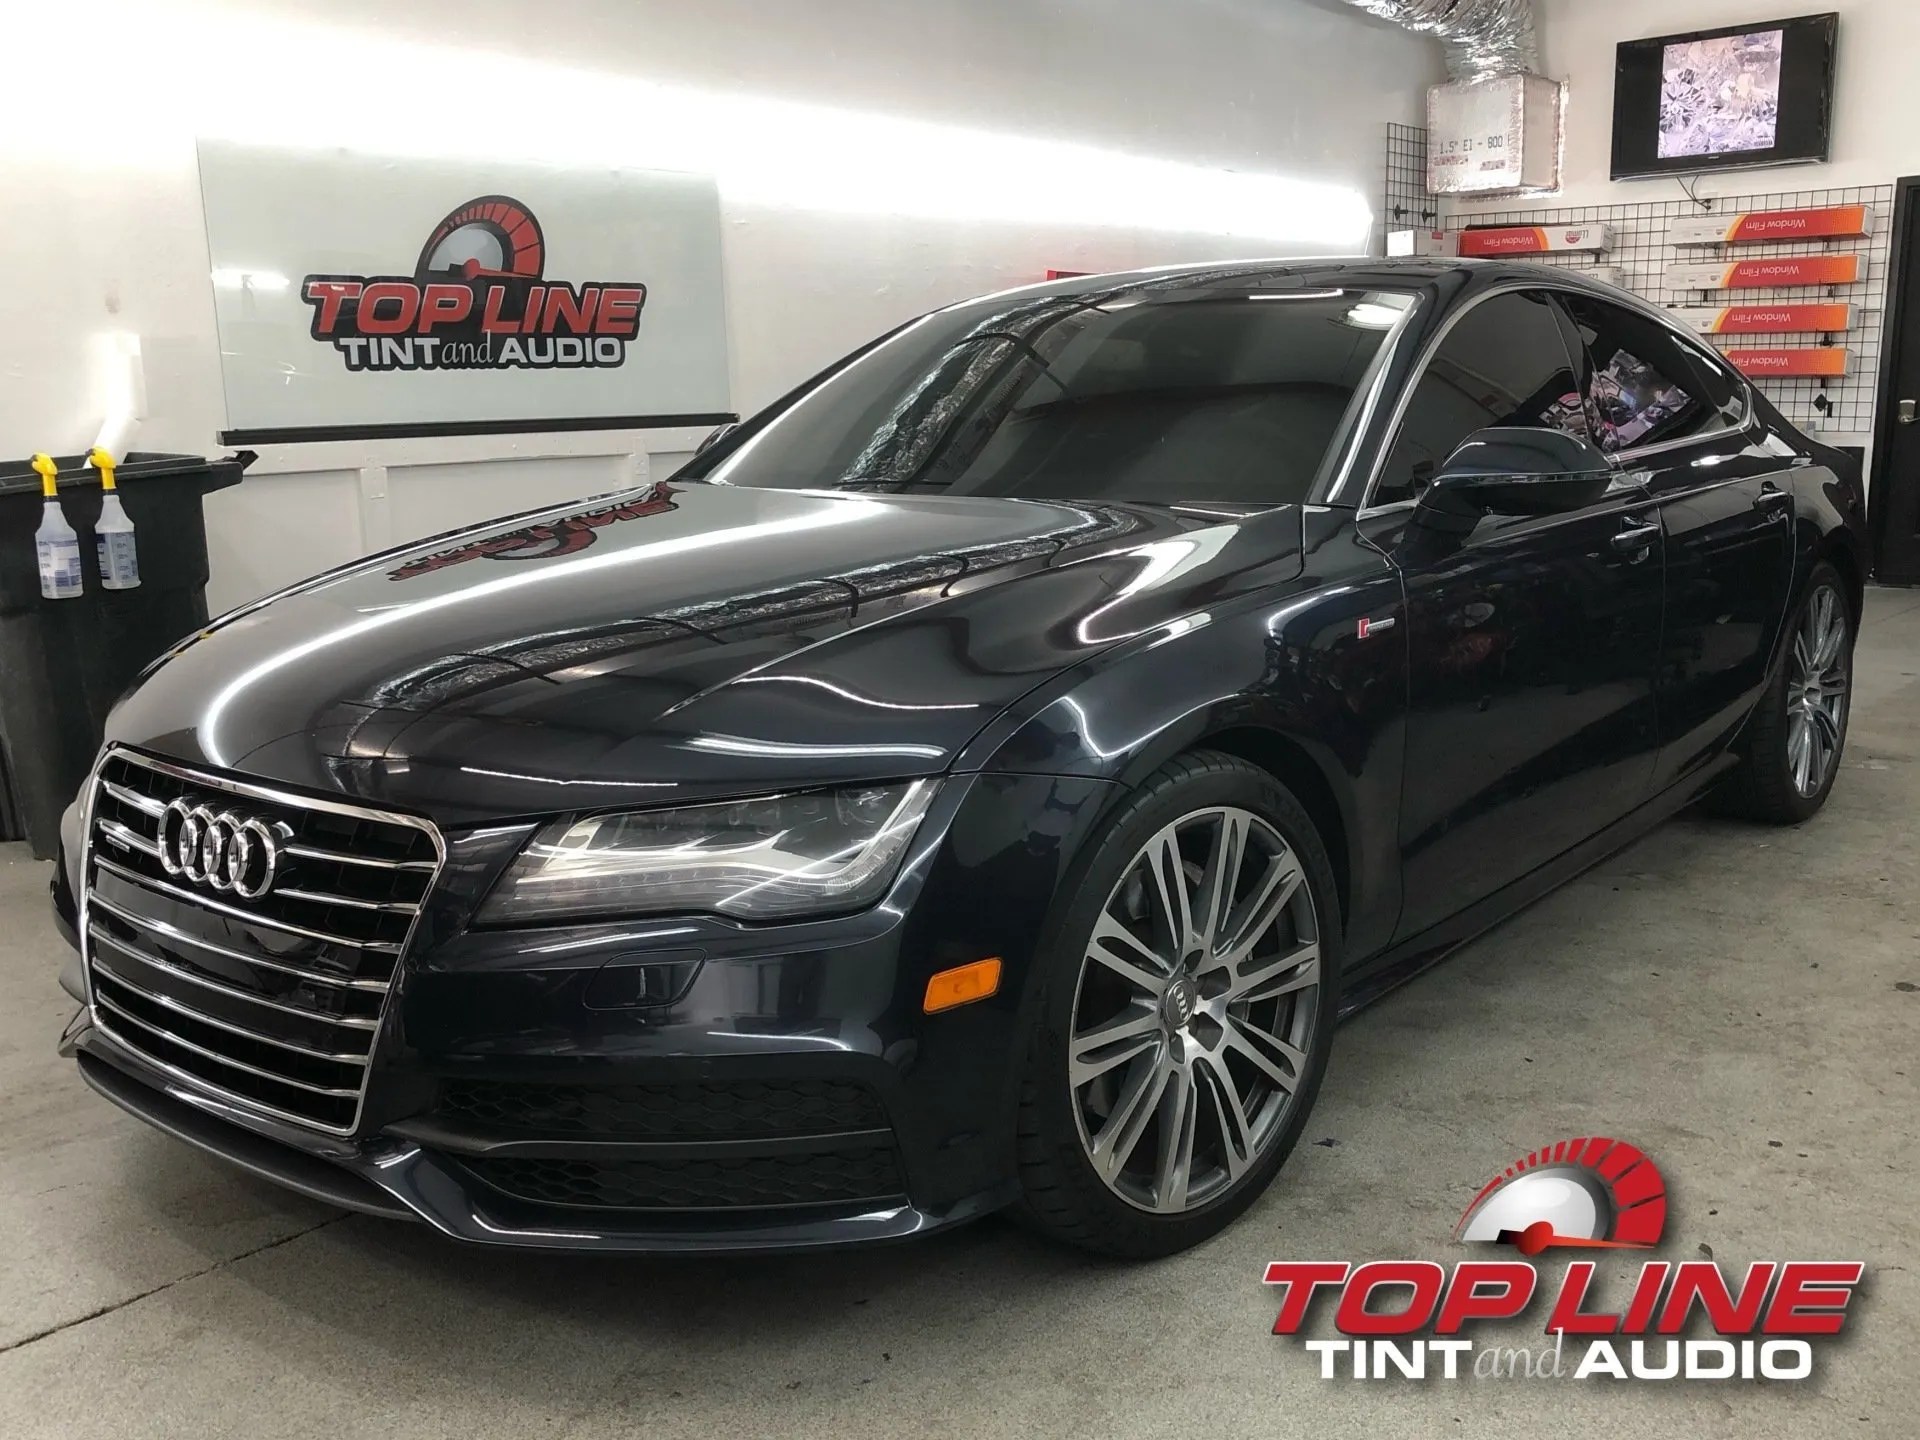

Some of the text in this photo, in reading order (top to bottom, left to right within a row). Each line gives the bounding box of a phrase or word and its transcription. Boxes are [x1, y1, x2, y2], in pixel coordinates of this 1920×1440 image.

[1745, 218, 1806, 230] Window Film
[1483, 236, 1534, 247] Window Film
[1739, 266, 1800, 277] Window Film
[307, 282, 642, 333] TOP LINE
[1731, 313, 1792, 323] Window Film
[339, 329, 622, 365] TINT and AUDIO
[1750, 357, 1789, 367] Window
